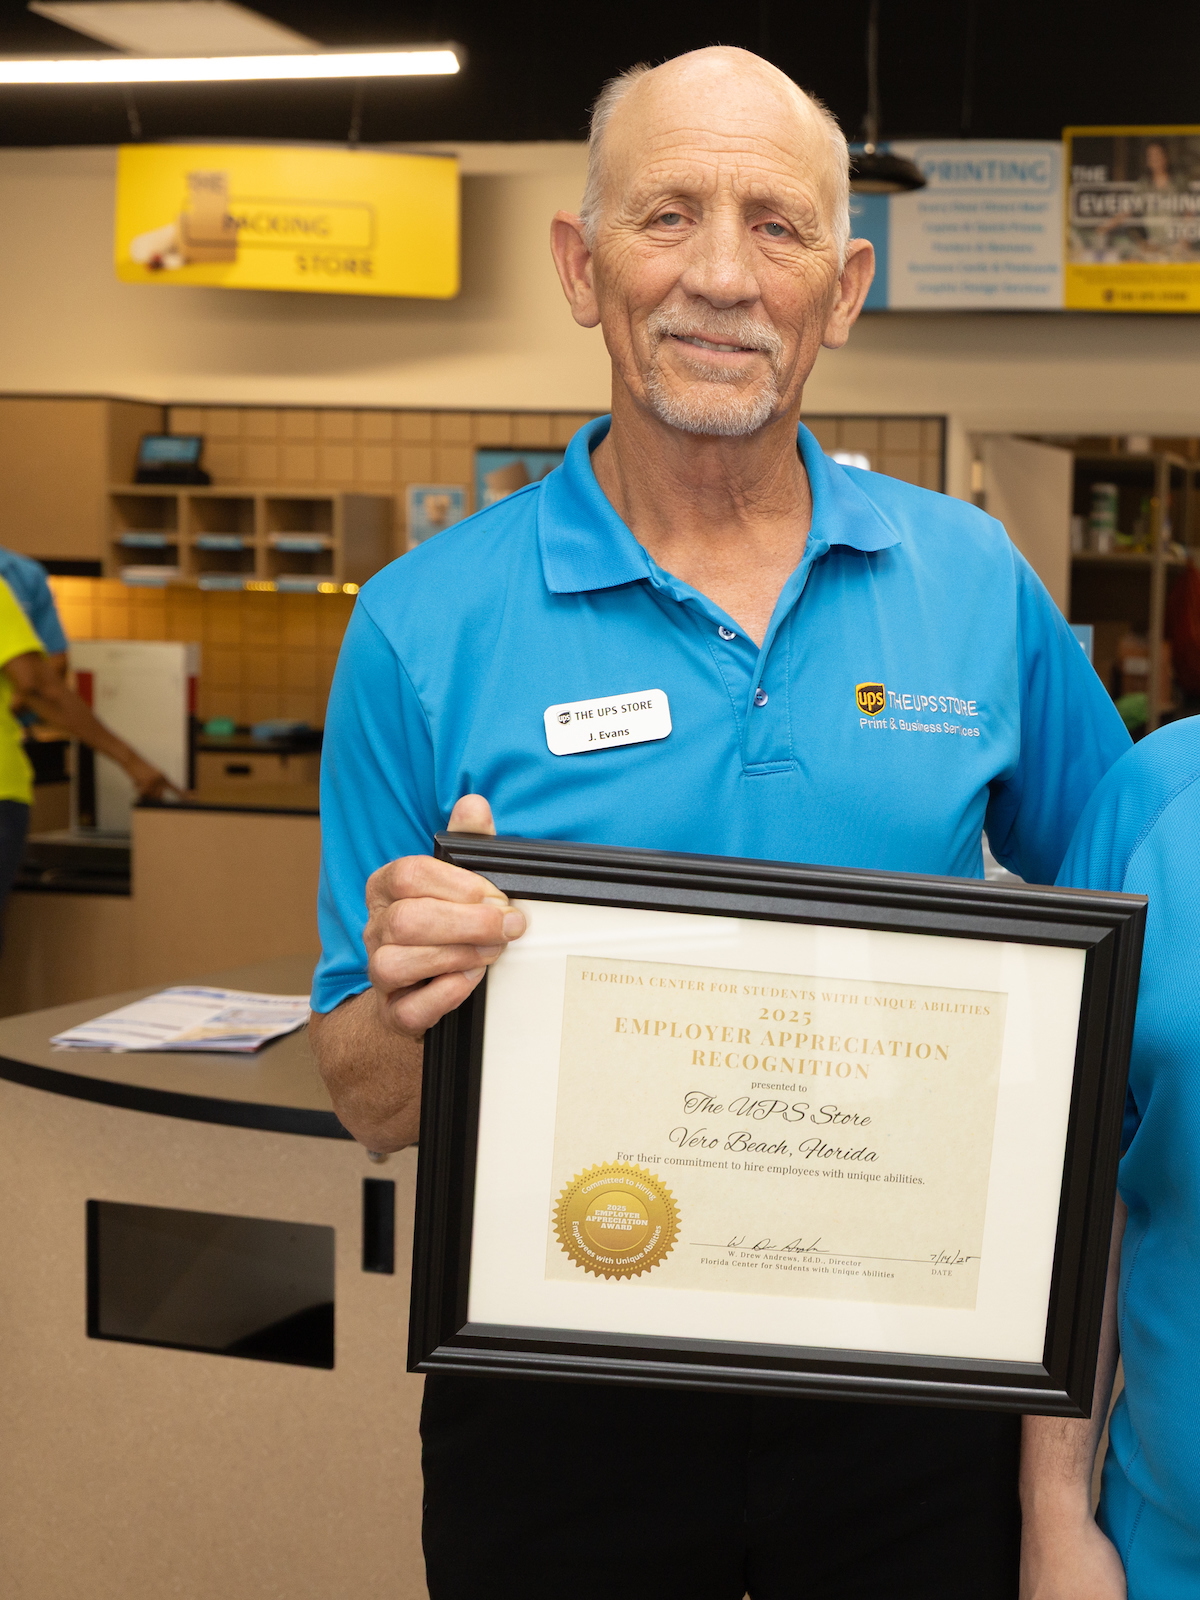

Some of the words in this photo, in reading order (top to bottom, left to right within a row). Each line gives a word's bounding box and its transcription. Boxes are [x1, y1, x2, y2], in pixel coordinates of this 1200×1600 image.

[924, 160, 1047, 182] PRINTING
[1072, 165, 1106, 181] THE
[223, 212, 330, 236] PACKING
[296, 253, 374, 277] STORE
[575, 710, 594, 721] THE
[597, 706, 618, 717] UPS
[621, 700, 653, 714] STORE
[857, 691, 884, 711] ups
[887, 691, 913, 710] THE
[912, 694, 938, 712] UPS
[939, 696, 979, 716] STORE
[588, 732, 597, 742] J.
[599, 728, 630, 740] Evans
[860, 717, 888, 730] Print
[889, 717, 898, 730] &
[899, 719, 942, 734] Business
[943, 722, 980, 737] Services
[581, 971, 644, 986] FLORIDA
[649, 977, 705, 991] CENTER
[710, 983, 738, 994] FOR
[743, 985, 816, 1000] STUDENTS
[821, 992, 859, 1005] WITH
[864, 996, 917, 1010] UNIQUE
[921, 1001, 990, 1016] ABILITIES
[758, 1008, 812, 1026] 2025
[614, 1016, 752, 1045] EMPLOYER
[760, 1029, 950, 1061] APPRECIATION
[691, 1049, 870, 1080] RECOGNITION
[751, 1081, 796, 1092] presented
[798, 1084, 807, 1093] to
[683, 1090, 724, 1114] The
[728, 1096, 809, 1122] UPS
[810, 1104, 871, 1127] Store
[669, 1126, 719, 1149] Vero
[723, 1130, 793, 1158] Beach,
[798, 1137, 879, 1162] Florida
[617, 1151, 634, 1161] For
[637, 1153, 661, 1164] their
[664, 1156, 728, 1169] commitment
[731, 1160, 741, 1170] to
[744, 1161, 764, 1172] hire
[767, 1164, 819, 1177] employees
[822, 1168, 844, 1179] with
[847, 1172, 881, 1183] unique
[883, 1173, 925, 1185] abilities.
[581, 1177, 624, 1194] Committed
[626, 1178, 634, 1186] to
[635, 1182, 656, 1201] Hiring
[586, 1215, 648, 1226] APPRECIATION
[595, 1210, 640, 1218] EMPLOYER
[601, 1222, 632, 1231] AWARD
[572, 1221, 595, 1258] Employees
[596, 1255, 614, 1264] with
[616, 1252, 644, 1265] Unique
[643, 1225, 661, 1254] Abilities
[700, 1258, 729, 1266] Florida
[732, 1260, 758, 1268] Center
[775, 1264, 810, 1272] Students
[832, 1268, 859, 1277] Unique
[861, 1270, 895, 1279] Abilities
[763, 1254, 799, 1262] Andrews,
[829, 1258, 861, 1267] Director
[932, 1269, 952, 1277] DATE
